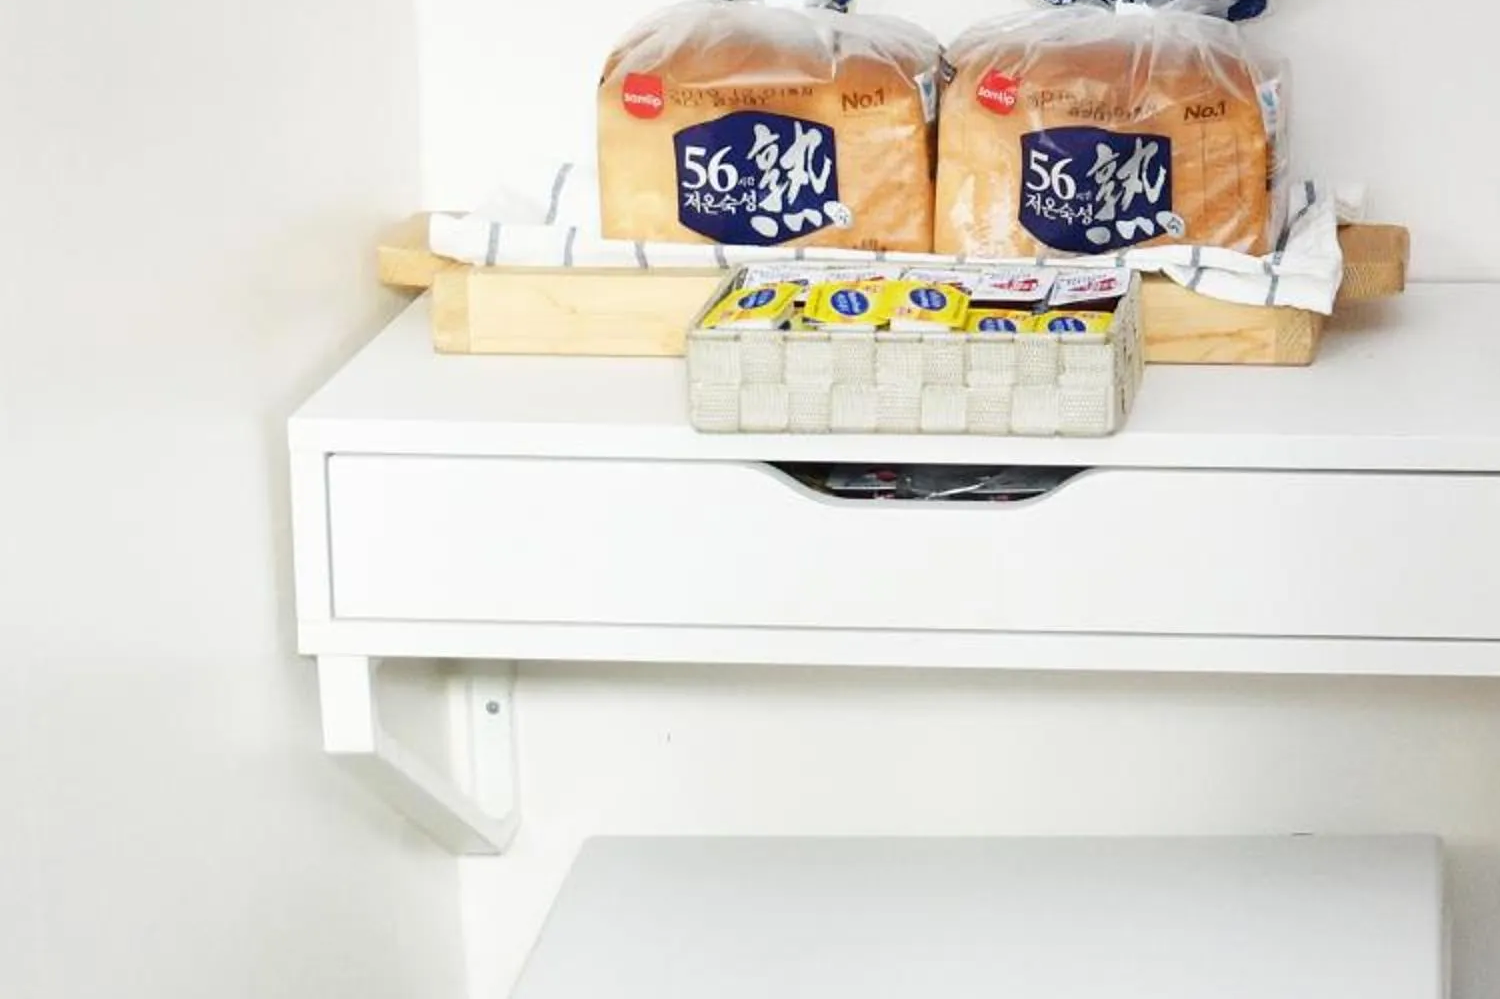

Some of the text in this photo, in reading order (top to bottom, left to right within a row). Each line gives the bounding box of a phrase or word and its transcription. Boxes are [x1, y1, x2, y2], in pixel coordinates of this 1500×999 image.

[841, 89, 886, 111] No.1
[1184, 99, 1228, 120] No.1
[684, 189, 757, 215] 저온숙성
[1025, 192, 1093, 225] 저온숙성
